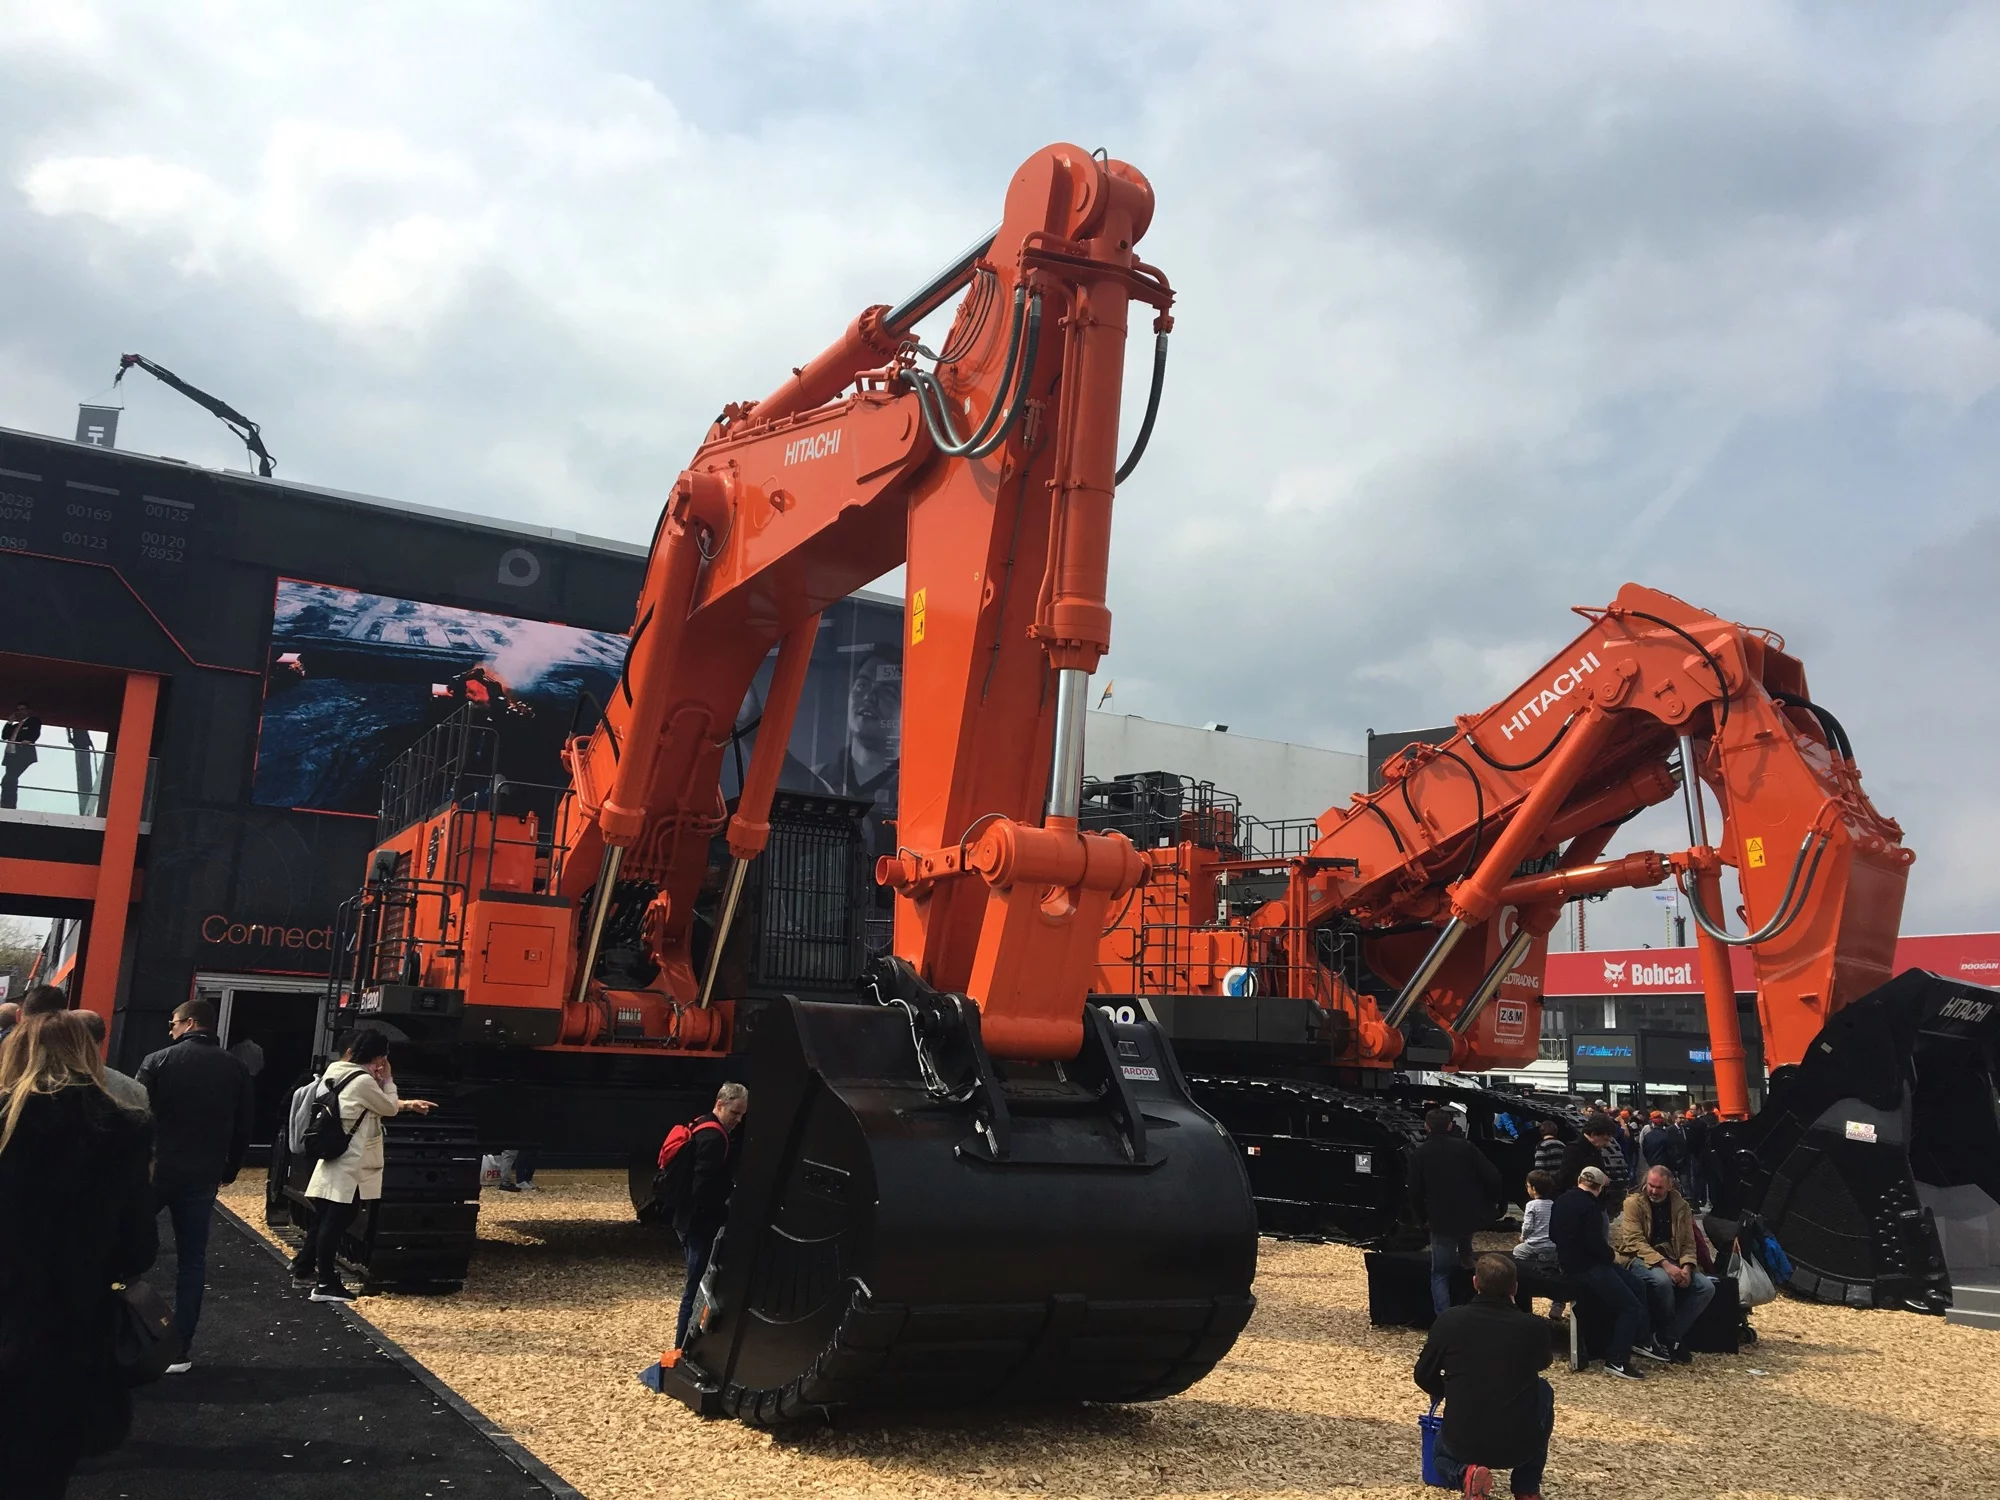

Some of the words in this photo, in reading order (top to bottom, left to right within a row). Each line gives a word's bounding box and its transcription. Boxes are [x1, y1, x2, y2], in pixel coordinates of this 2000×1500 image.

[784, 429, 841, 466] HITACHI
[66, 504, 112, 521] 00169
[145, 504, 189, 521] 00125
[62, 531, 108, 549] 00123
[141, 531, 186, 549] 00120
[140, 545, 183, 562] 78952
[1501, 652, 1601, 740] HITACHI
[202, 915, 334, 950] Connect
[1632, 963, 1692, 986] Bobcat
[1939, 997, 1994, 1023] HITACHI
[1124, 1068, 1154, 1076] ARDOX
